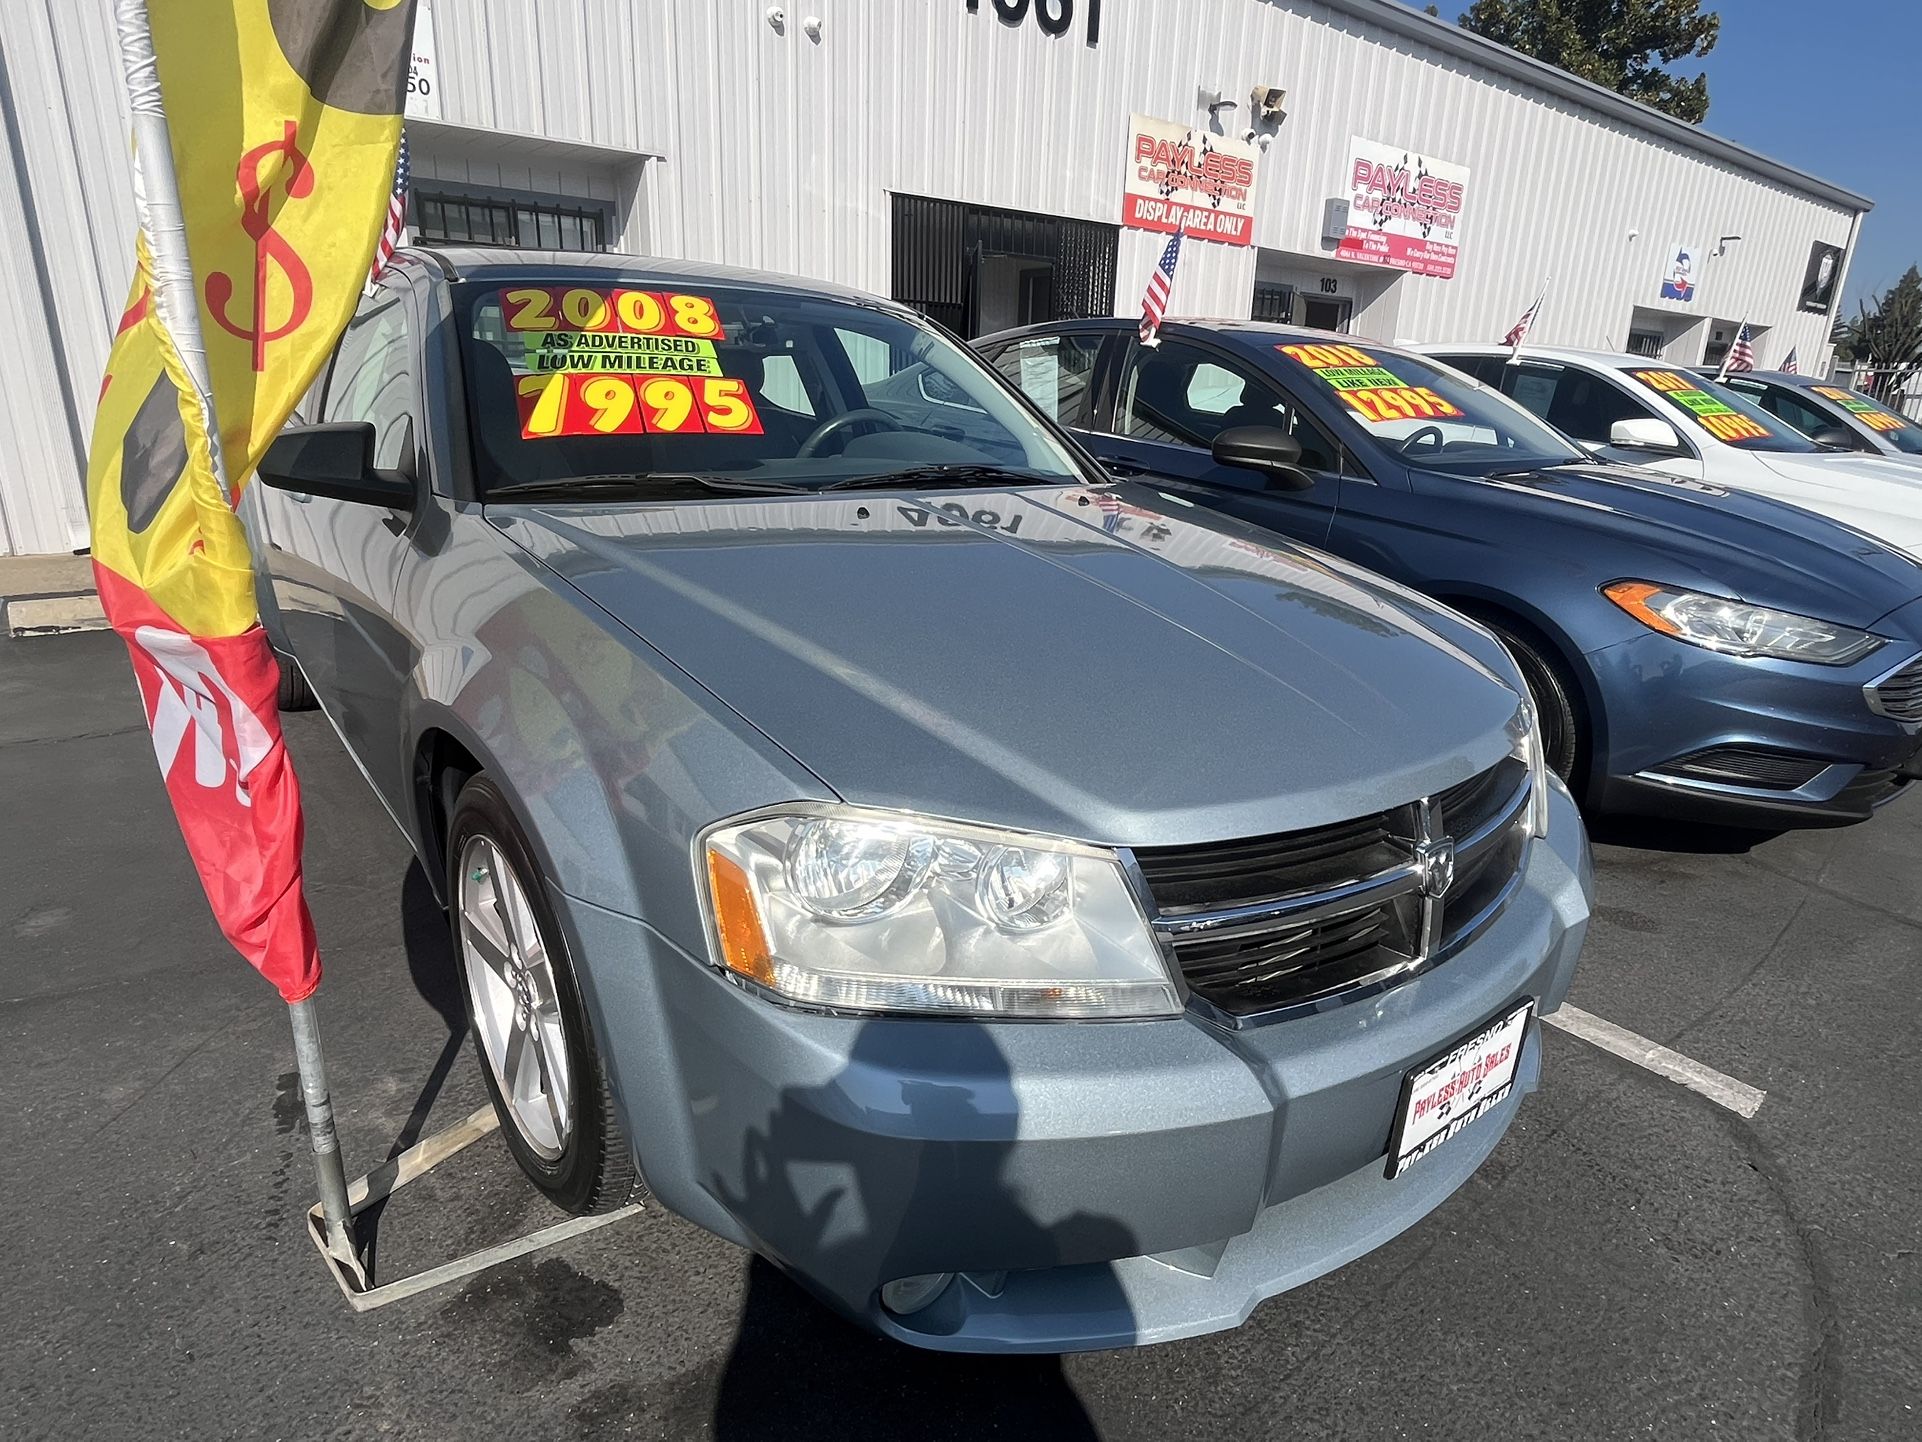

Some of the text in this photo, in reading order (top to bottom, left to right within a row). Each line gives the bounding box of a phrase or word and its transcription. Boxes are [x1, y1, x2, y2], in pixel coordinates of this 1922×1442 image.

[1135, 134, 1254, 187] PAYLESS
[1137, 166, 1248, 201] CAR CONNECTION
[1352, 157, 1464, 213] PAYLESS
[1135, 199, 1245, 236] DISPLAY AREA ONLY
[1353, 194, 1456, 230] CAR CONNECTION
[1320, 277, 1337, 293] 103
[506, 288, 720, 337] 2008
[541, 333, 700, 354] AS ADVERTISED
[1281, 344, 1378, 367] 2018
[537, 354, 711, 373] LOW MILEAGE
[1320, 368, 1349, 377] LOW
[1335, 378, 1400, 389] LIKE NEW
[518, 373, 754, 436] 7995
[1338, 387, 1460, 422] 12995
[1697, 414, 1771, 441] 10995
[1448, 1021, 1503, 1064] FRESNO
[1412, 1080, 1457, 1125] PAYLESS
[1457, 1062, 1483, 1095] AUTO
[1482, 1043, 1512, 1078] SALES
